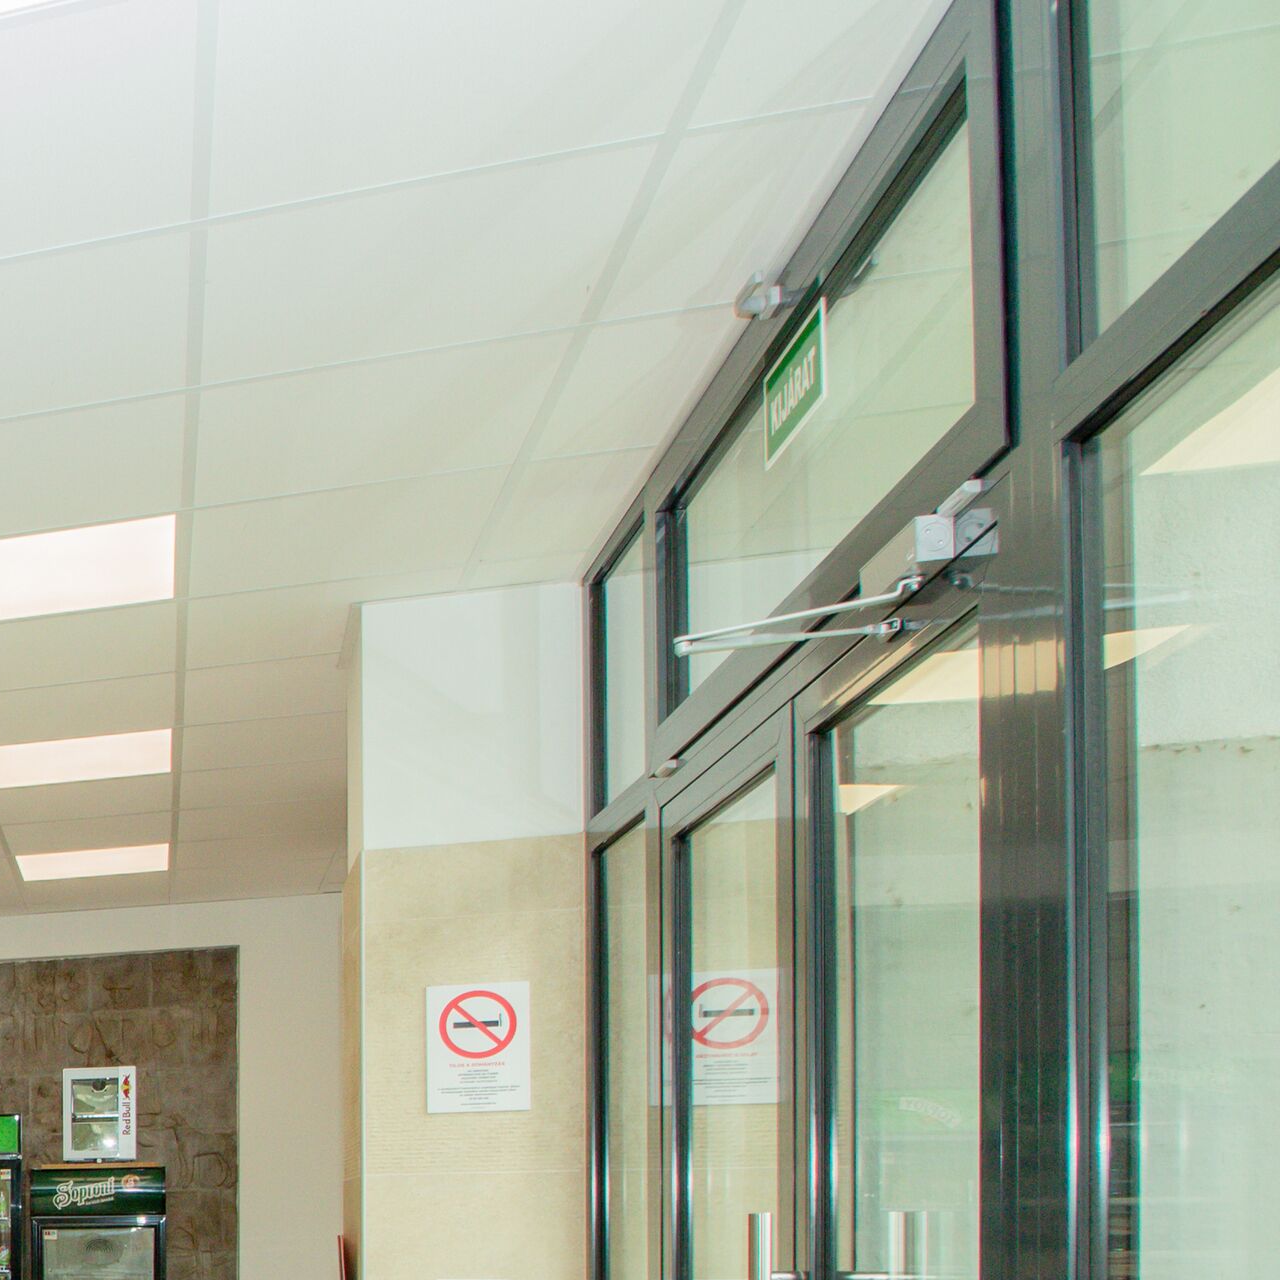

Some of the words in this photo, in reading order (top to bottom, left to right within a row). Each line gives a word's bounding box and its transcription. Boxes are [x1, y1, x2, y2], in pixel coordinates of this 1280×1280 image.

[770, 345, 816, 436] KIJÁRAT
[122, 1101, 131, 1118] Bull
[122, 1119, 131, 1136] Red
[52, 1176, 116, 1210] Soproni
